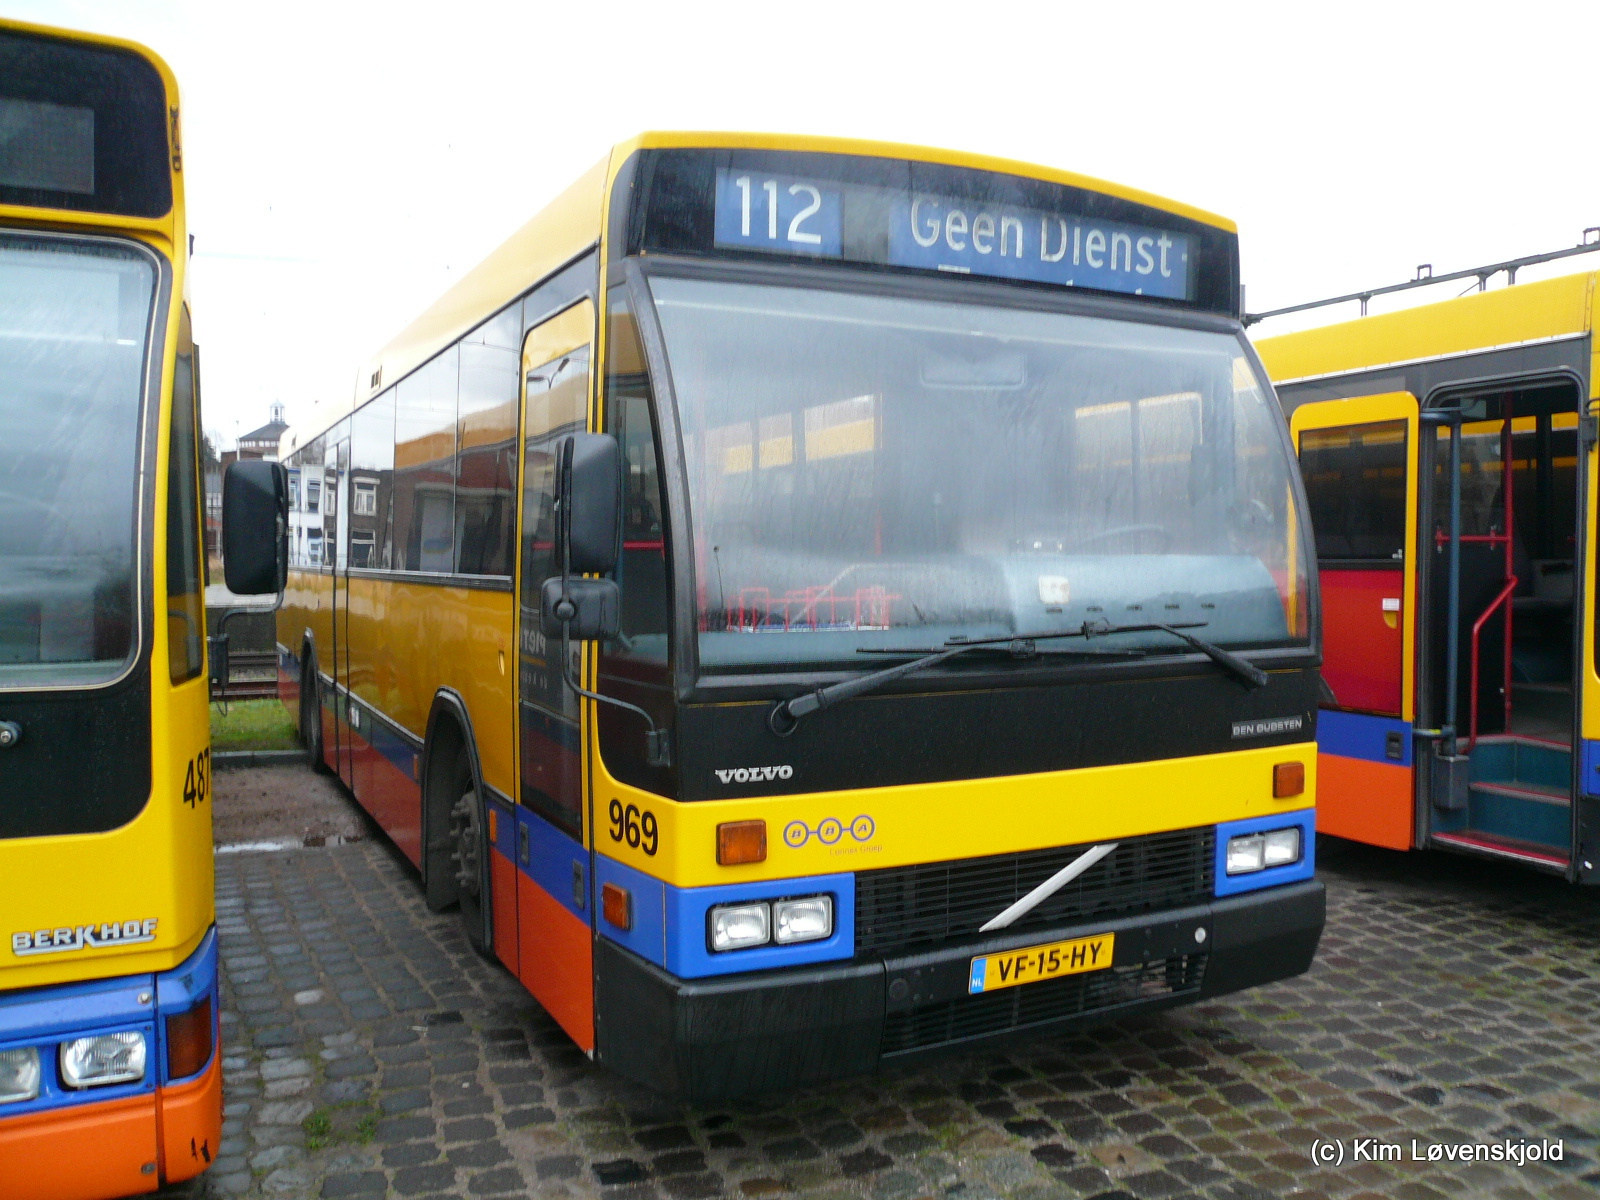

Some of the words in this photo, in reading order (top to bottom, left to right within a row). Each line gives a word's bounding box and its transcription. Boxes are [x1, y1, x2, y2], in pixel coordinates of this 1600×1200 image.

[735, 175, 822, 245] 112
[910, 198, 1024, 259] Geen
[1040, 217, 1173, 278] Dienst
[1232, 724, 1254, 736] DEN
[715, 764, 793, 784] VOLVO
[608, 799, 659, 856] 969
[12, 918, 158, 951] BERKHOF
[998, 941, 1103, 982] VF-15-HY
[972, 978, 983, 989] NL
